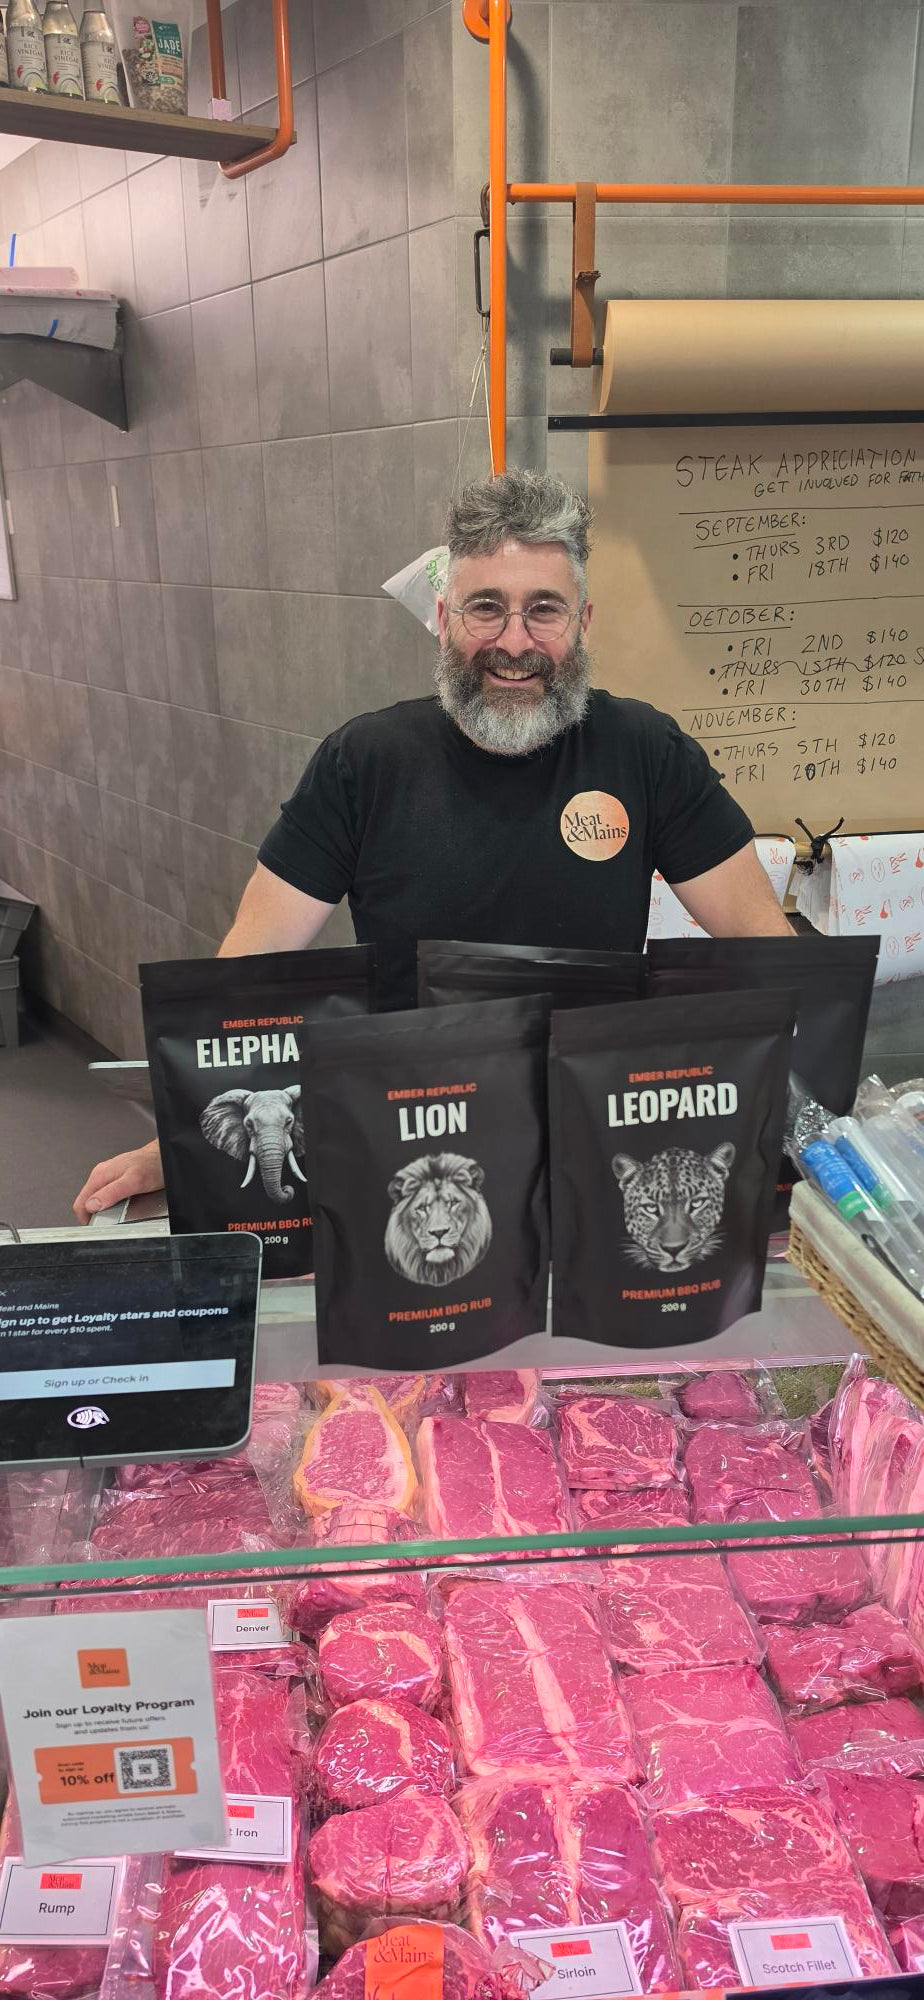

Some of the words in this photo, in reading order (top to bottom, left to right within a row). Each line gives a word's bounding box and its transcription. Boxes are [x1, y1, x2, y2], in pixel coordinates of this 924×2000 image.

[158, 38, 180, 52] JADE
[676, 454, 763, 488] STEAK
[776, 448, 916, 478] APPRECIATION
[754, 480, 790, 498] GET
[799, 474, 858, 492] INVOLVED
[868, 471, 891, 488] FOR
[696, 512, 806, 541] SEPTEMBER:
[746, 540, 800, 561] THURS
[815, 534, 850, 555] 3RD
[872, 527, 909, 547] $120
[748, 563, 774, 584] FRI
[808, 556, 849, 579] 18TH
[869, 554, 910, 574] $140
[740, 637, 772, 658] FRI
[801, 634, 844, 654] 2ND
[866, 628, 909, 644] $140
[718, 660, 780, 682] THURS
[864, 654, 907, 672] $120
[734, 679, 766, 697] FRI
[800, 678, 846, 696] 30TH
[862, 675, 907, 692] $140
[690, 706, 796, 732] NOVEMBER:
[724, 742, 779, 760] THURS
[797, 738, 838, 755] 5TH
[858, 732, 896, 748] $120
[735, 764, 766, 784] FRI
[856, 757, 898, 774] $140
[564, 811, 602, 828] Meat
[566, 824, 627, 842] &Mains
[222, 1020, 257, 1029] EMBER
[258, 1015, 304, 1026] REPUBLIC
[196, 1032, 300, 1068] ELEPHA
[628, 1070, 664, 1083] EMBER
[666, 1065, 714, 1080] REPUBLIC
[387, 1088, 424, 1100] EMBER
[426, 1082, 477, 1097] REPUBLIC
[608, 1082, 738, 1128] LEOPARD
[399, 1101, 466, 1142] LION
[227, 1220, 276, 1232] PREMIUM
[278, 1218, 300, 1230] BBQ
[264, 1236, 281, 1244] 200
[282, 1236, 289, 1244] g
[622, 1288, 675, 1300] PREMIUM
[677, 1284, 699, 1296] BBQ
[700, 1279, 721, 1291] RUB
[388, 1308, 443, 1322] PREMIUM
[444, 1302, 468, 1316] BBQ
[470, 1297, 492, 1311] RUB
[661, 1302, 679, 1312] 200
[19, 1318, 35, 1326] up
[38, 1316, 50, 1324] to
[52, 1314, 73, 1325] get
[74, 1312, 119, 1324] Loyalty
[120, 1312, 150, 1320] stars
[152, 1309, 176, 1319] and
[178, 1307, 229, 1318] coupons
[70, 1326, 86, 1334] $10
[86, 1325, 113, 1333] spent.
[430, 1322, 448, 1333] 200
[449, 1322, 456, 1332] g
[44, 1379, 68, 1388] Sign
[102, 1375, 136, 1384] Check
[23, 1709, 51, 1719] Join
[56, 1707, 78, 1716] our
[82, 1702, 132, 1715] Loyalty
[136, 1698, 195, 1710] Program
[60, 1774, 90, 1786] 10%
[94, 1772, 115, 1784] off
[236, 1827, 258, 1837] Iron
[39, 1902, 75, 1916] Rump
[374, 1947, 435, 1963] &Mains
[557, 1966, 597, 1980] Sirloin
[762, 1962, 806, 1974] Scotch
[807, 1959, 837, 1972] Fillet
